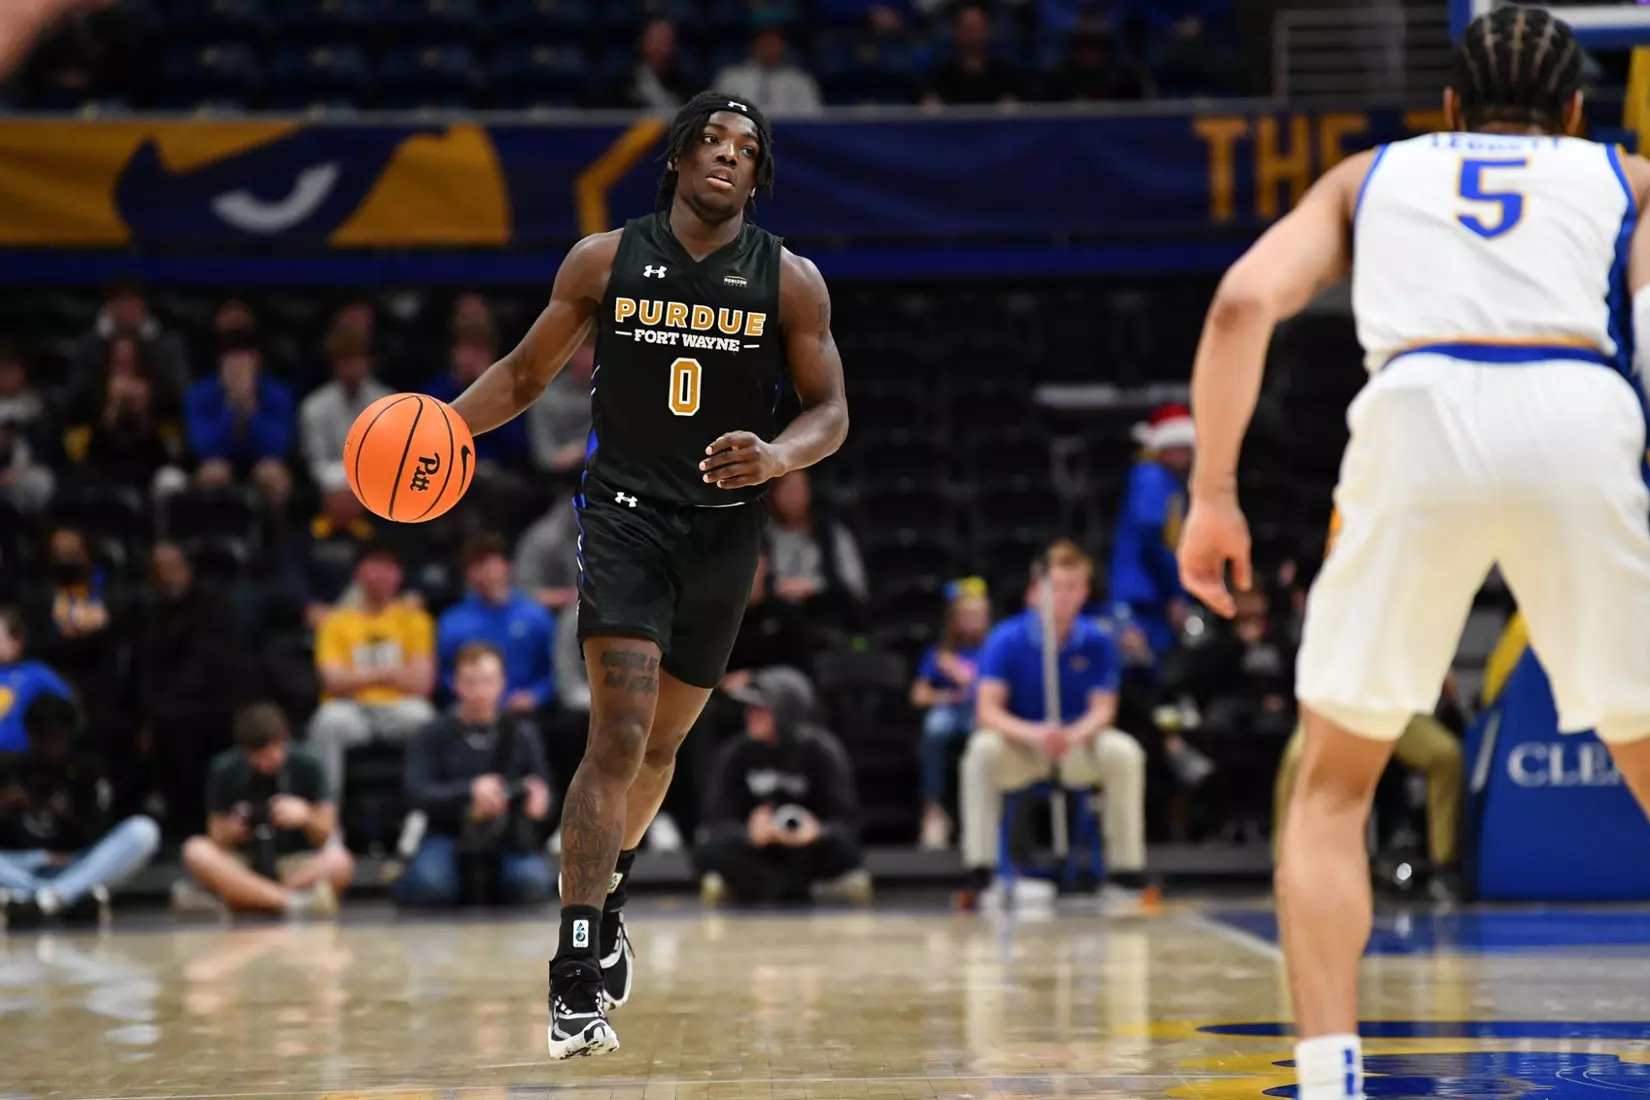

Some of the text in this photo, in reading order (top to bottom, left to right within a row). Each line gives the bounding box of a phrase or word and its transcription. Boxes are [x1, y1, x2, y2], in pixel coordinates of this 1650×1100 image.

[1455, 156, 1530, 240] 5
[615, 297, 767, 336] PURDUE
[634, 328, 740, 352] FORT WAYNE
[668, 357, 702, 416] 0
[409, 452, 441, 491] Pitt
[1507, 741, 1621, 787] CLE
